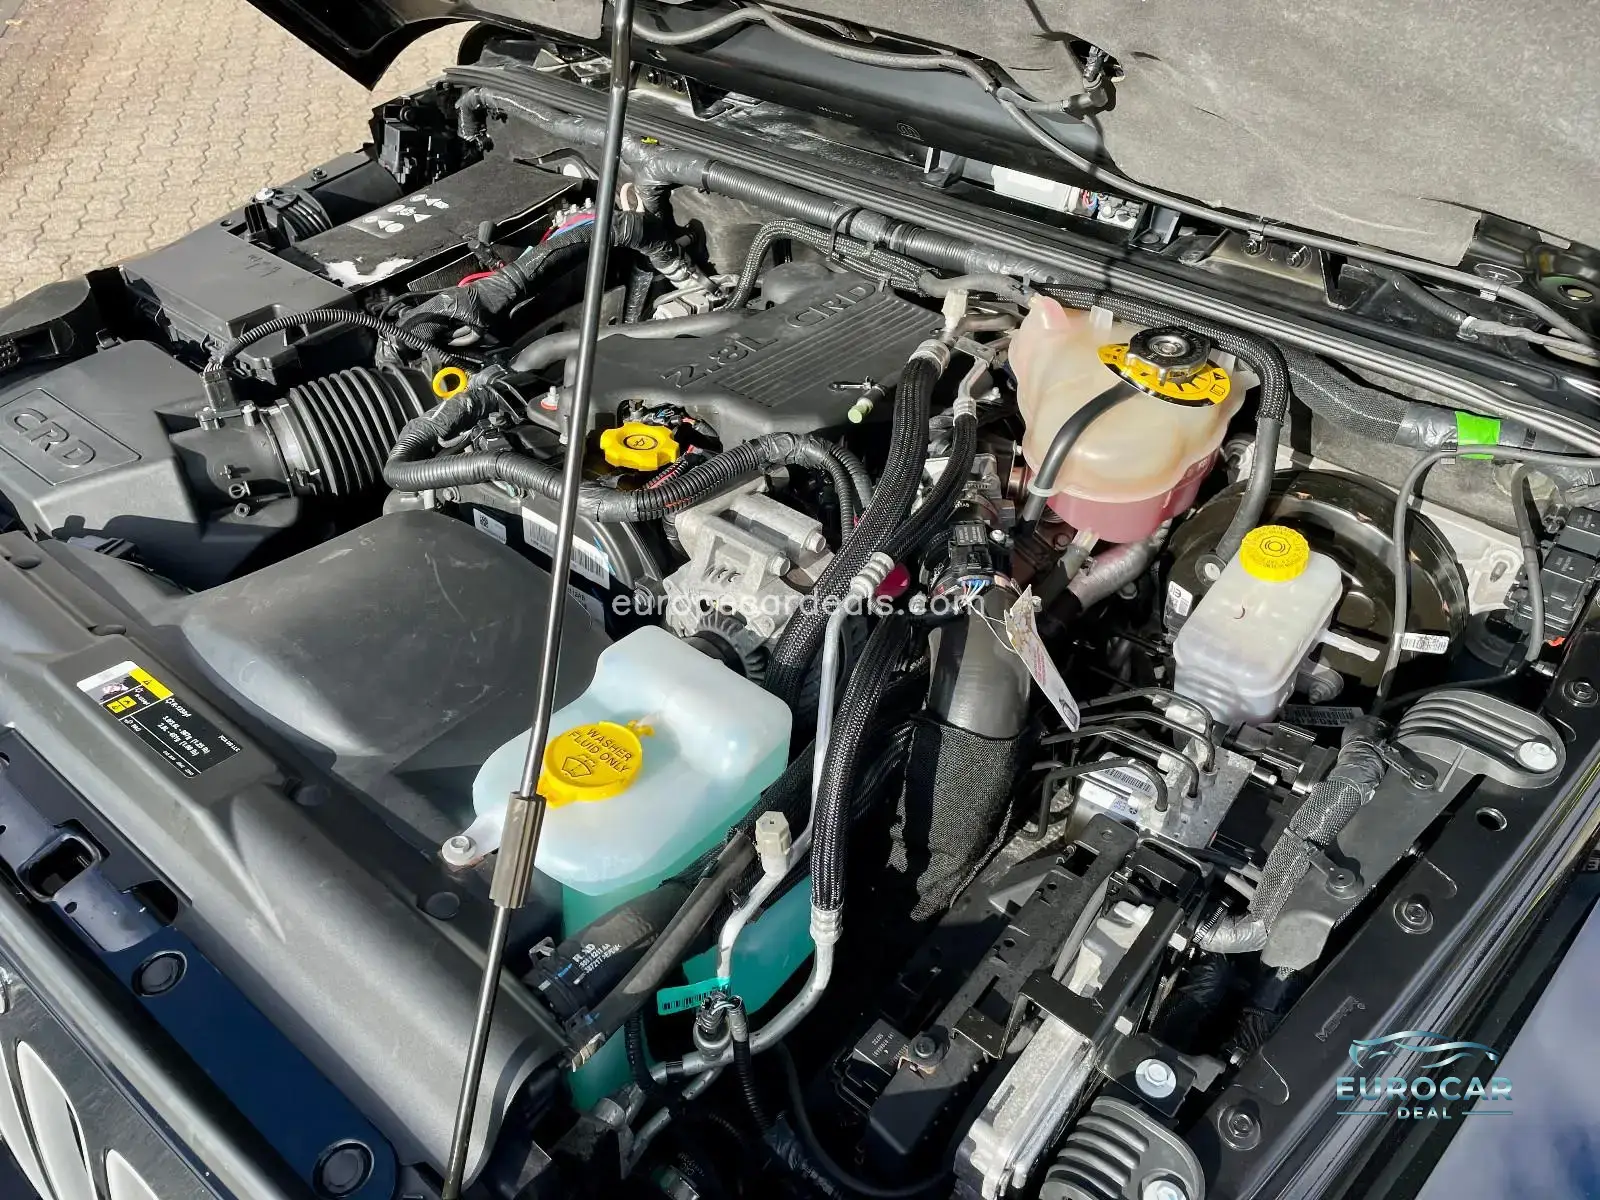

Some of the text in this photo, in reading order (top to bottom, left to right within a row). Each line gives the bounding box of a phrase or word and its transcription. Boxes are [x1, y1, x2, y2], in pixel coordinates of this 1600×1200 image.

[660, 282, 877, 389] 2.8L CRD
[4, 406, 97, 469] CRD
[568, 730, 629, 773] FLUID ONLY
[586, 728, 632, 761] WASHER
